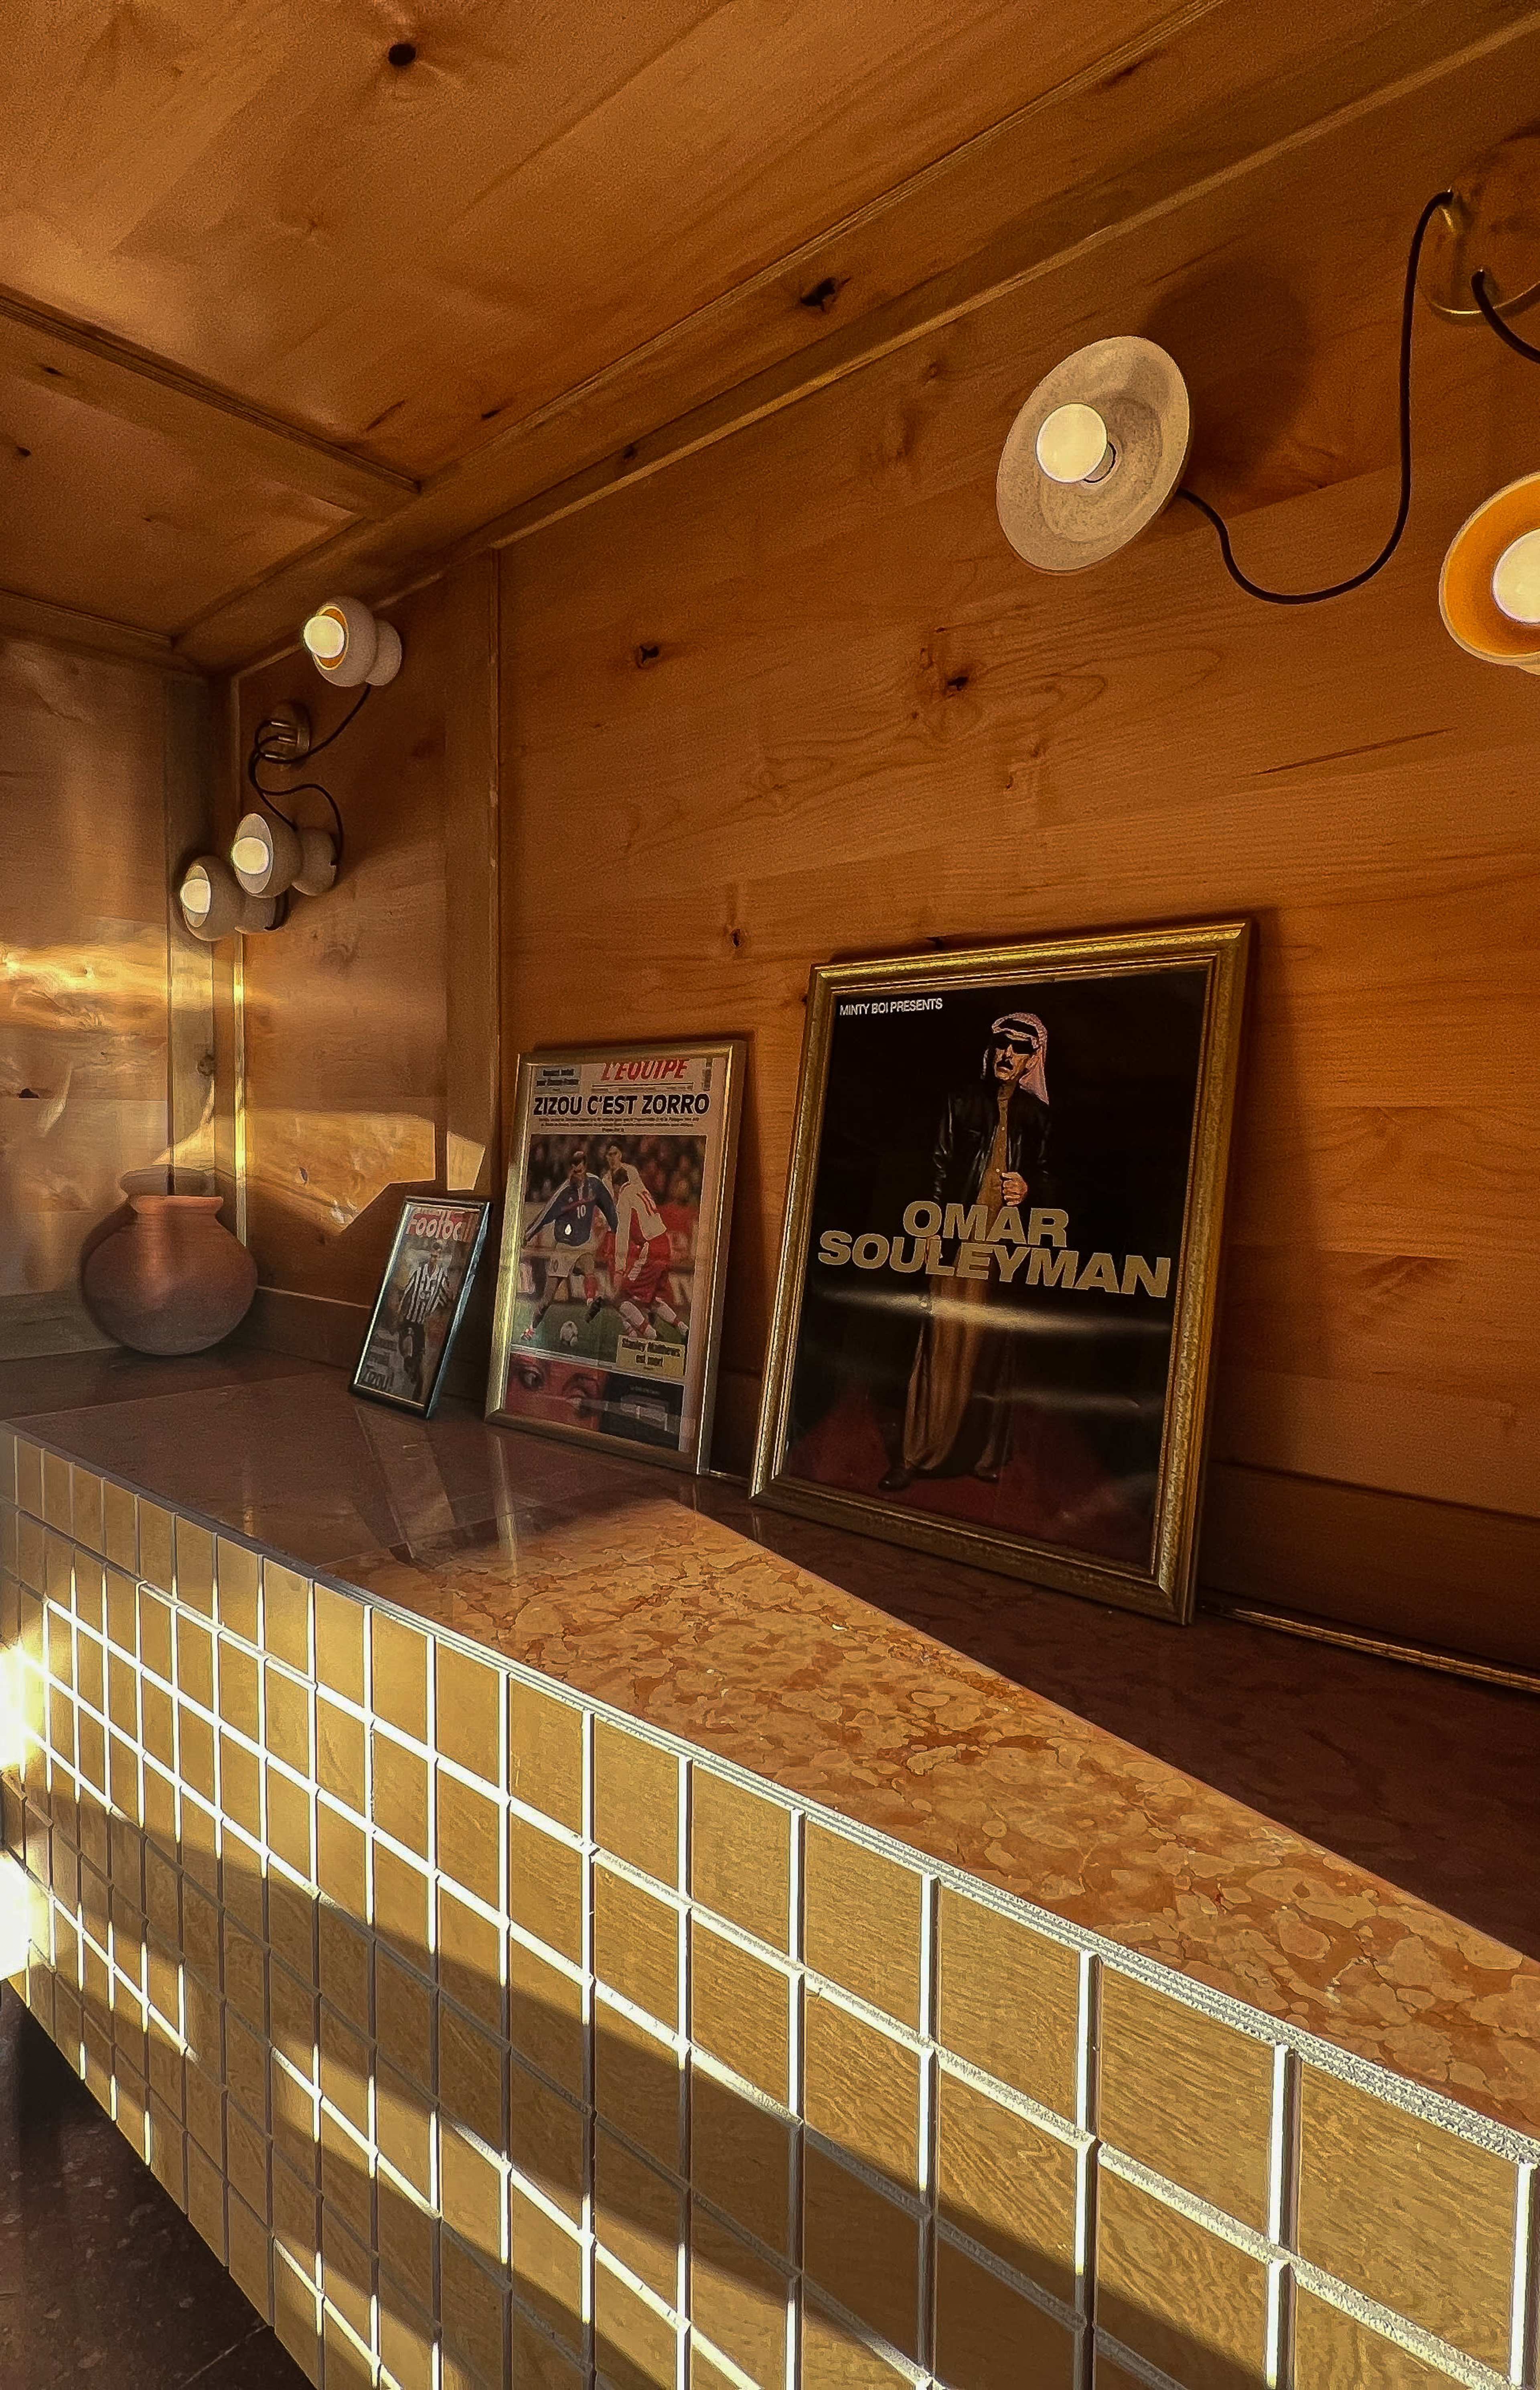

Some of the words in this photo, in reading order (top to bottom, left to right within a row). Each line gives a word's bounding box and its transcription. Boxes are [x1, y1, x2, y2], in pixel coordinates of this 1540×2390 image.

[840, 1004, 869, 1015] MINTY
[871, 1002, 888, 1013] BOI
[890, 998, 943, 1013] PRESENTS
[533, 1096, 583, 1115] ZIZOU
[587, 1094, 638, 1115] C'EST
[641, 1093, 710, 1115] ZORRO
[577, 1205, 586, 1219] 10
[903, 1201, 1068, 1247] OMAR
[818, 1230, 1171, 1298] SOULEYMAN
